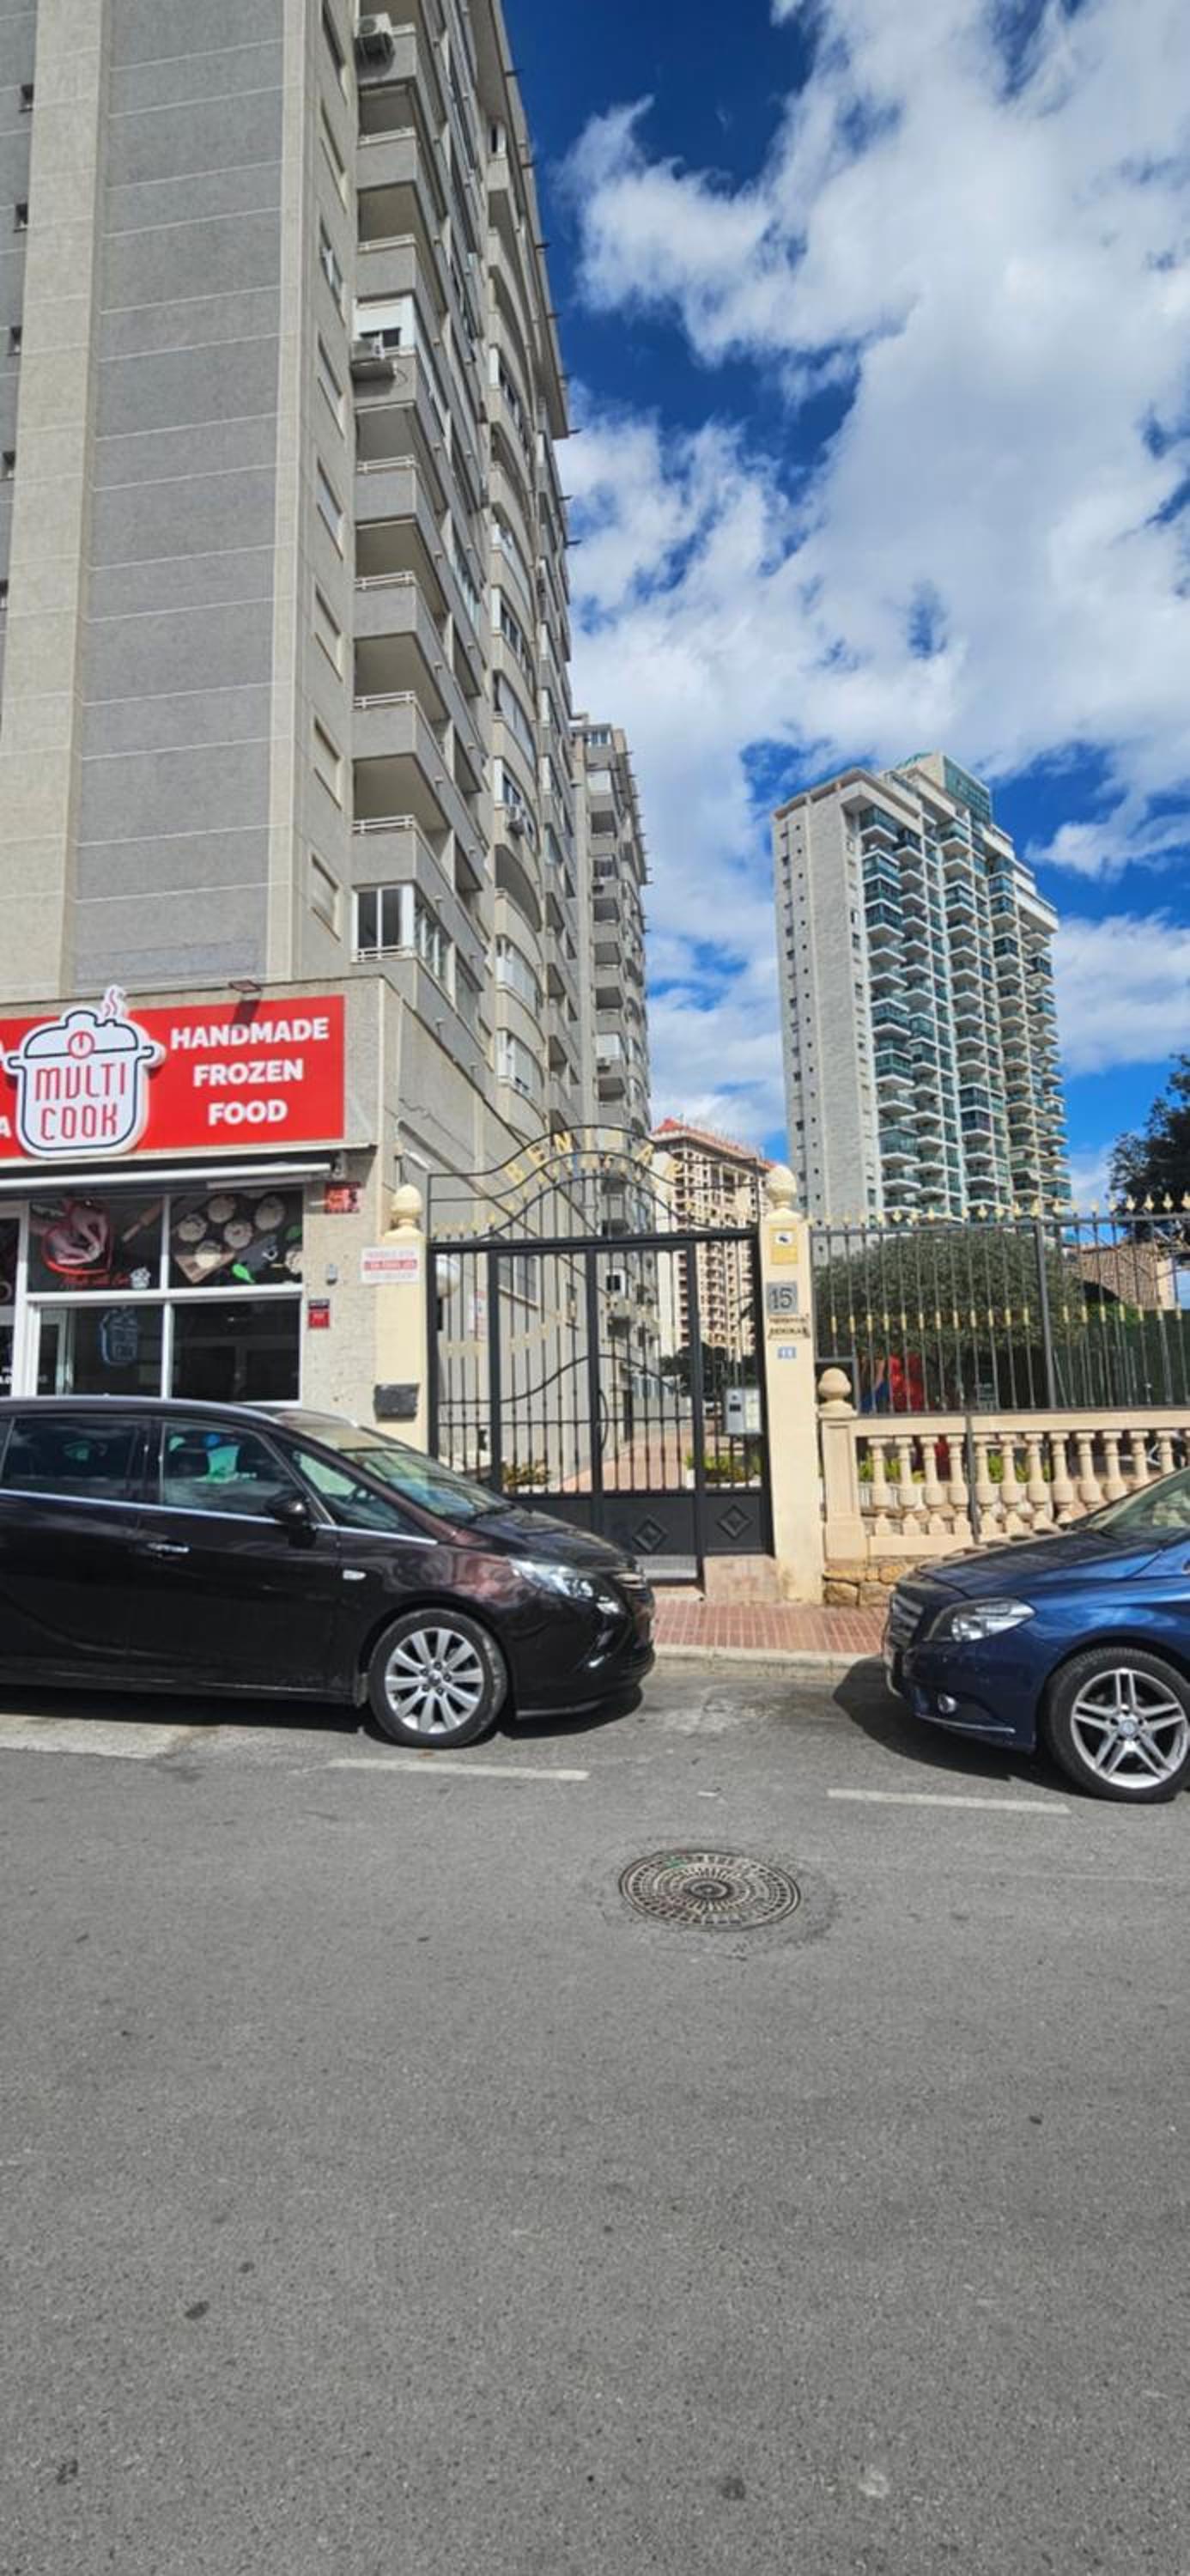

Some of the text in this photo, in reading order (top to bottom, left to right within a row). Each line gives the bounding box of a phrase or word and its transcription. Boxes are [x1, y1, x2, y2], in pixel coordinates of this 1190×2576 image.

[170, 1017, 330, 1050] HANDMADE
[34, 1061, 126, 1101] MULTI
[193, 1057, 304, 1088] FROZEN
[40, 1103, 118, 1141] COOK
[208, 1098, 288, 1127] FOOD
[769, 1287, 793, 1309] 15
